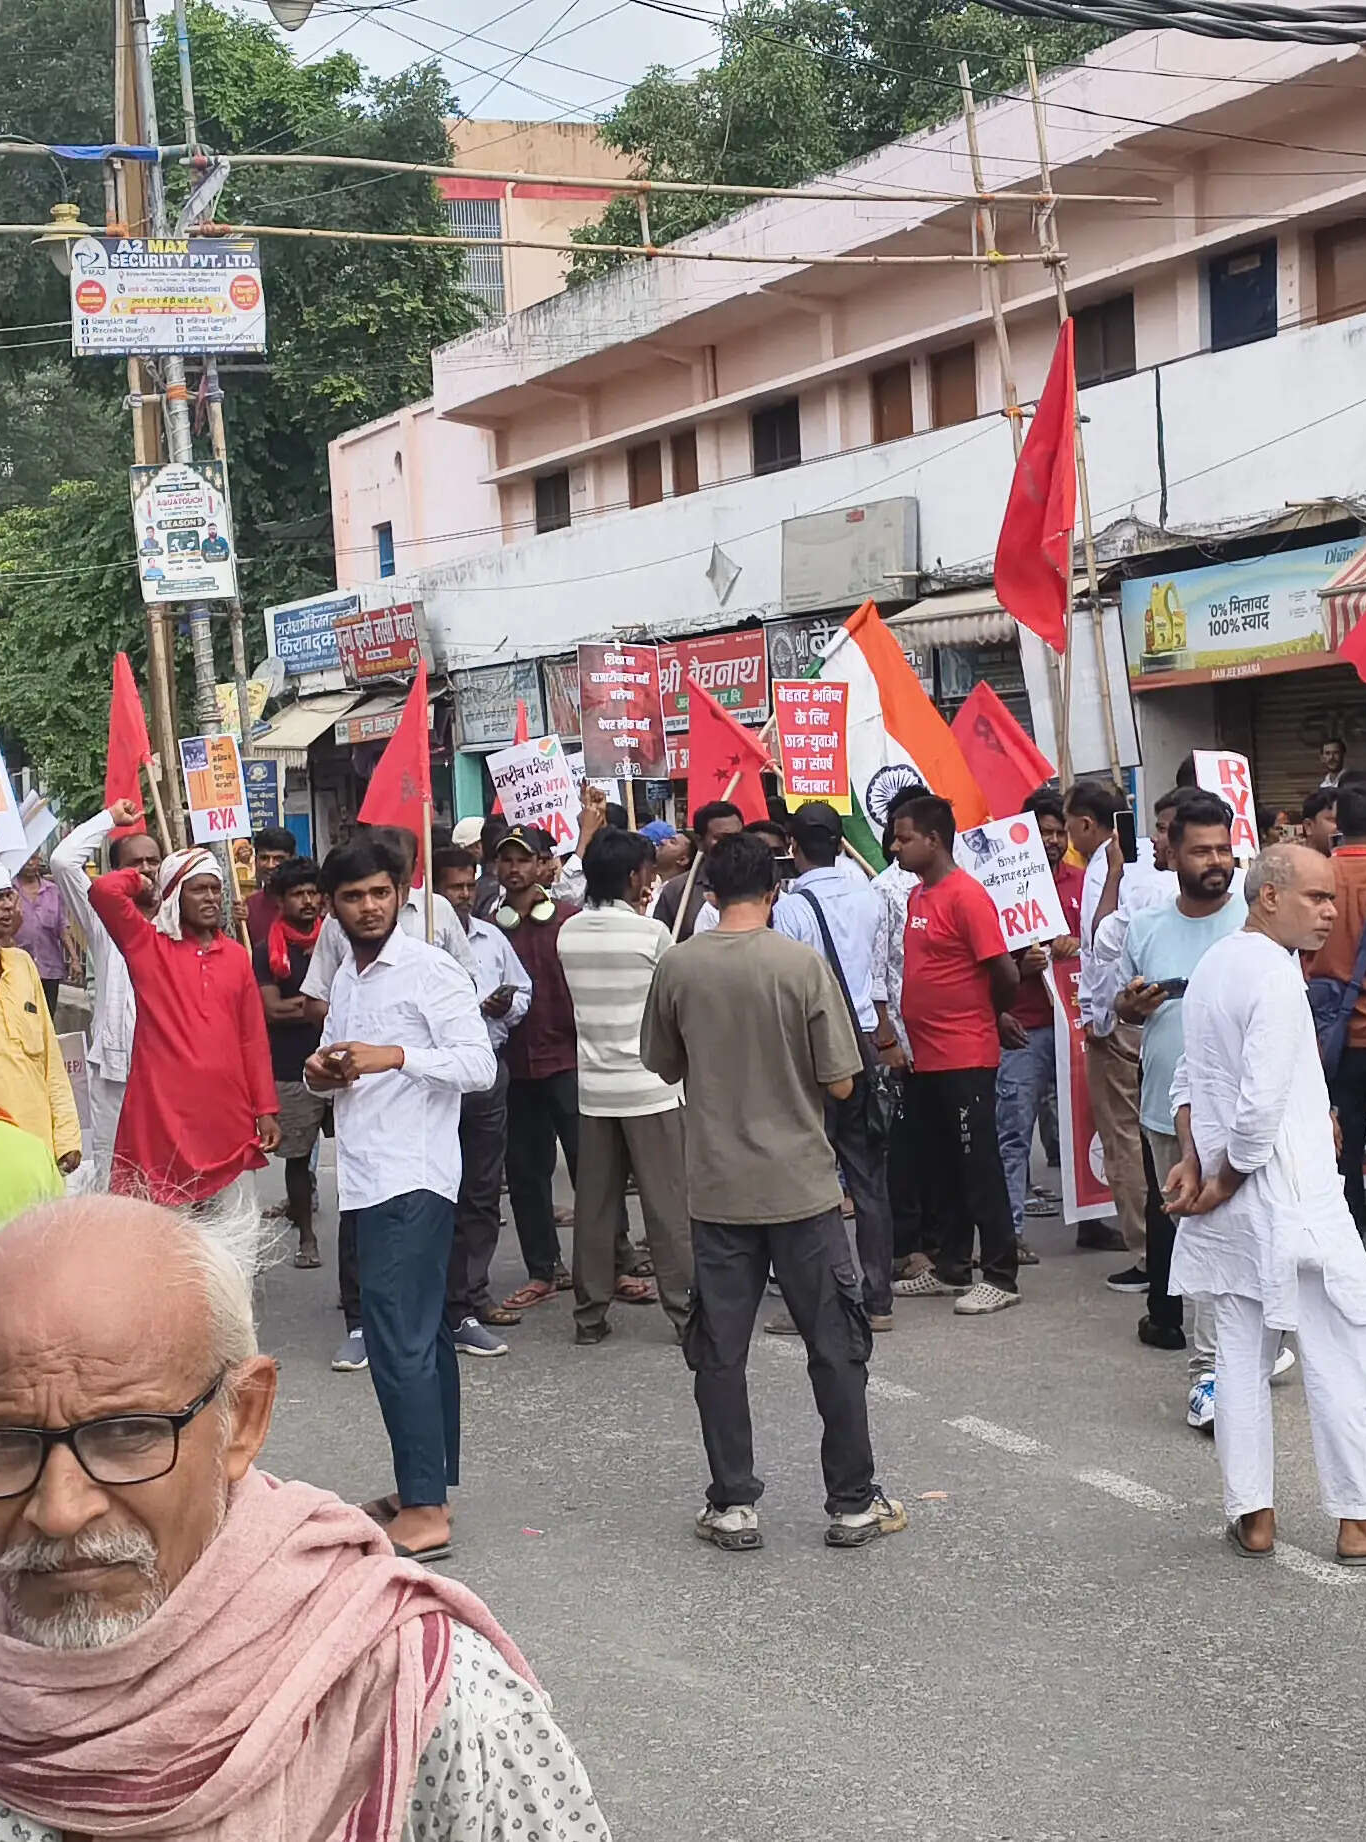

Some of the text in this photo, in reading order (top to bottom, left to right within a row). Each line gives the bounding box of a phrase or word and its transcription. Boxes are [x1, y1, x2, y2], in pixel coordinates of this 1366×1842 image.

[117, 240, 188, 253] A2 MAX
[110, 254, 256, 267] SECURITY PVT. LTD.
[1229, 595, 1270, 615] मिलावट
[1208, 612, 1270, 636] 100% स्वाद
[777, 685, 843, 704] बेहतर भविष्य
[795, 708, 830, 726] के लिए
[791, 757, 807, 771] का
[1218, 759, 1256, 849] RYA
[206, 807, 238, 831] RYA
[1001, 898, 1049, 937] RYA
